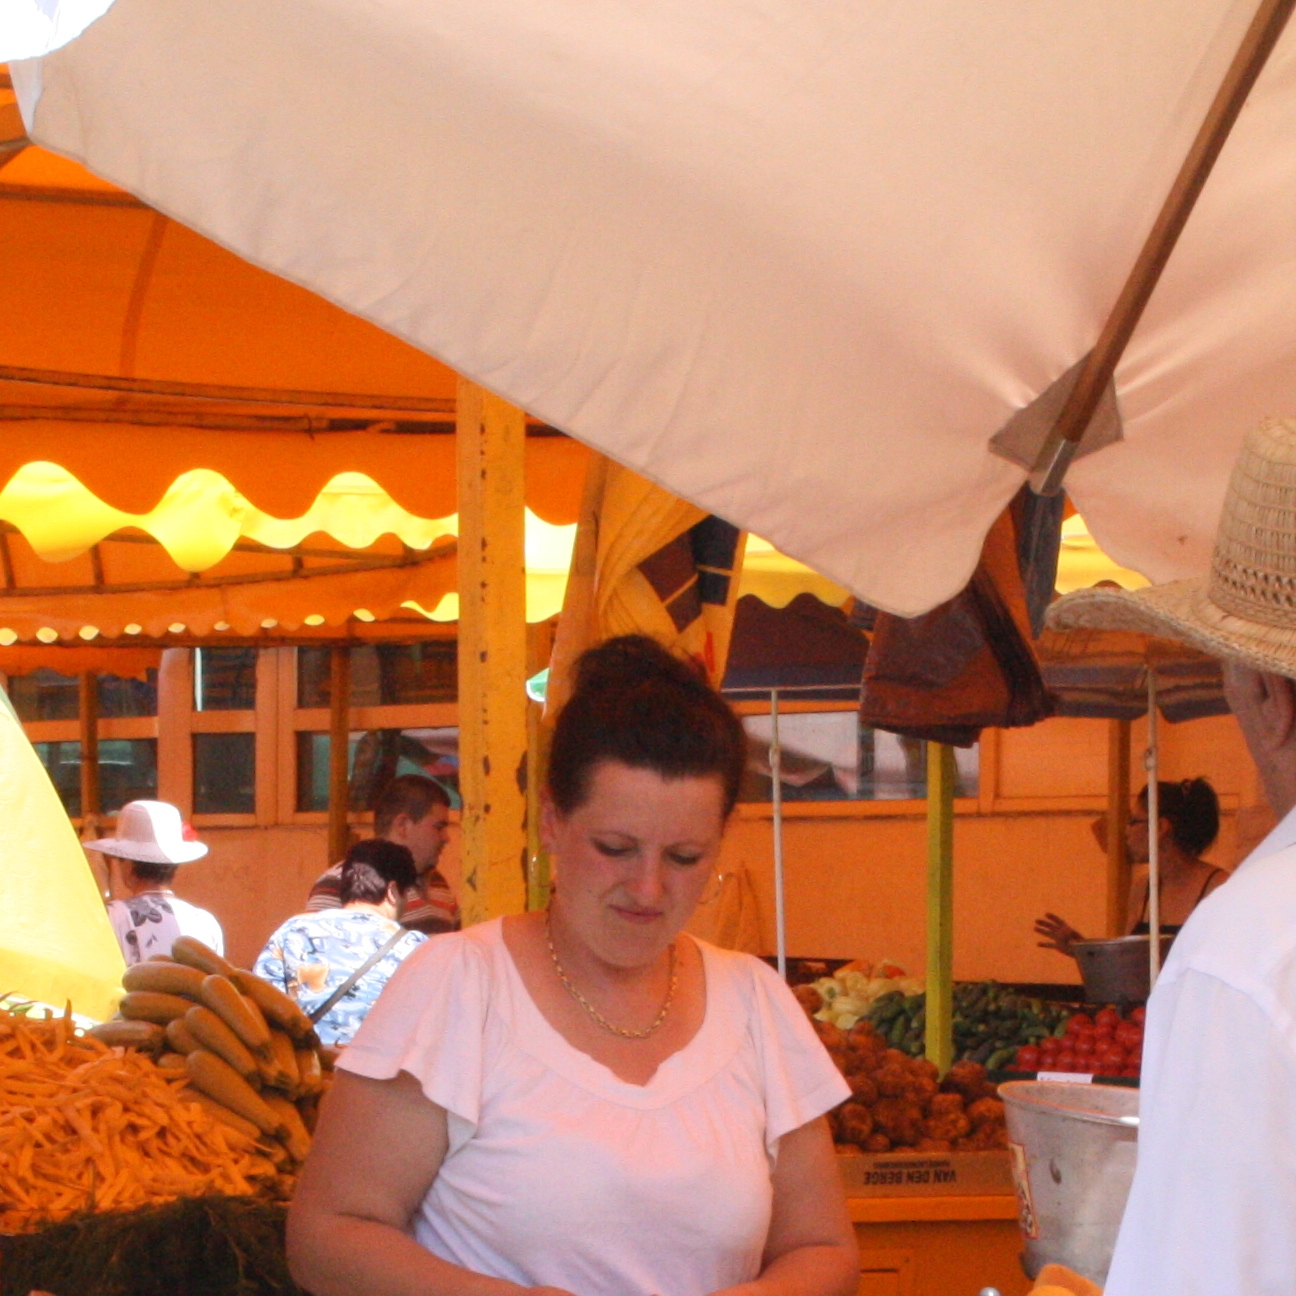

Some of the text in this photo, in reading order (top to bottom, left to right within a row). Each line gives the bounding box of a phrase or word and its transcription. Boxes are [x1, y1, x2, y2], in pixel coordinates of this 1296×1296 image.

[864, 1167, 956, 1186] VAN DEN BERGE
